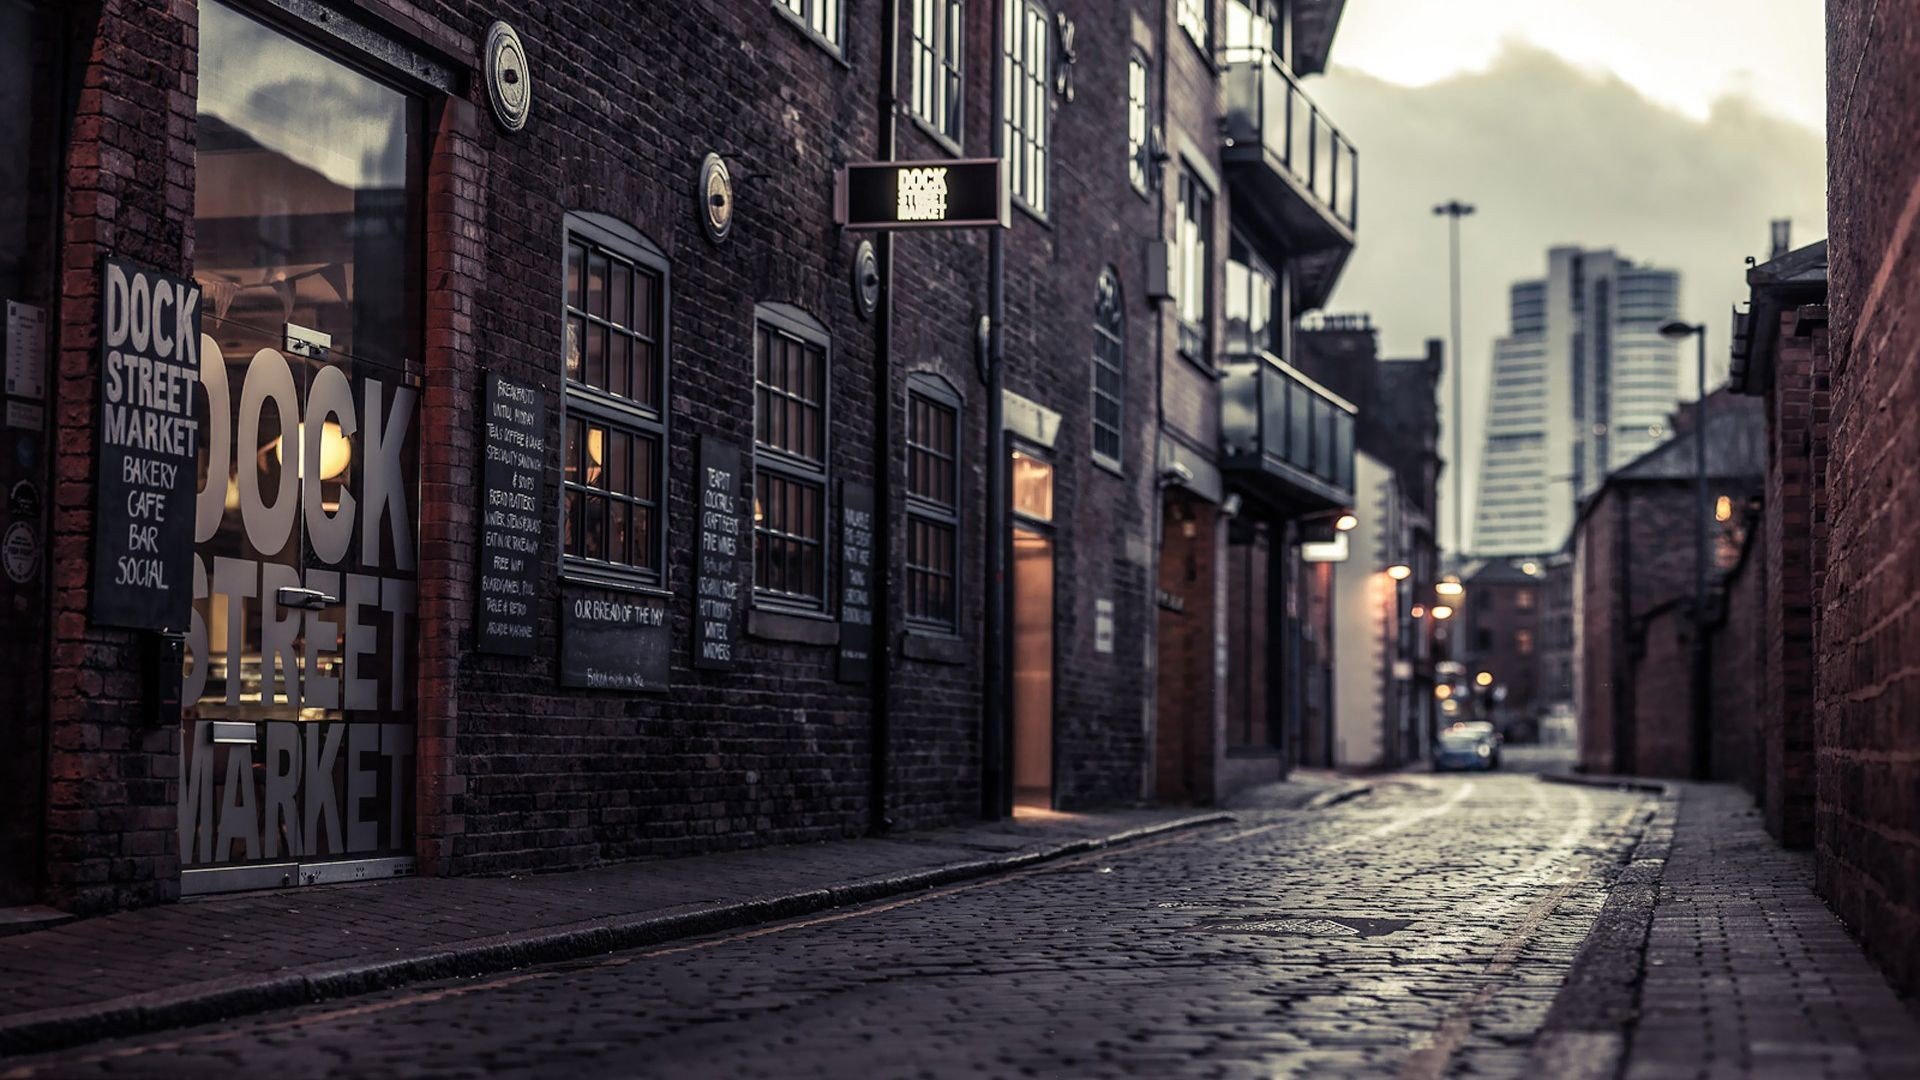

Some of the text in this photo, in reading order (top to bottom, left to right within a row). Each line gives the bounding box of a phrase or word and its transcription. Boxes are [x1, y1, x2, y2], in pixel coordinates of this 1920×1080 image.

[898, 168, 947, 191] DOCK
[107, 263, 199, 364] DOCK
[106, 350, 198, 417] STREET
[104, 402, 198, 458] MARKET
[504, 428, 524, 446] COFFEE
[123, 455, 177, 489] BAKERY
[518, 475, 534, 491] SOUPS
[127, 489, 166, 522] CAFE
[128, 524, 159, 554] BAR
[486, 532, 498, 546] EAT
[115, 555, 169, 590] SOCIAL
[494, 556, 509, 570] FREE
[575, 599, 664, 626] OUR BREAD OF THE DAY
